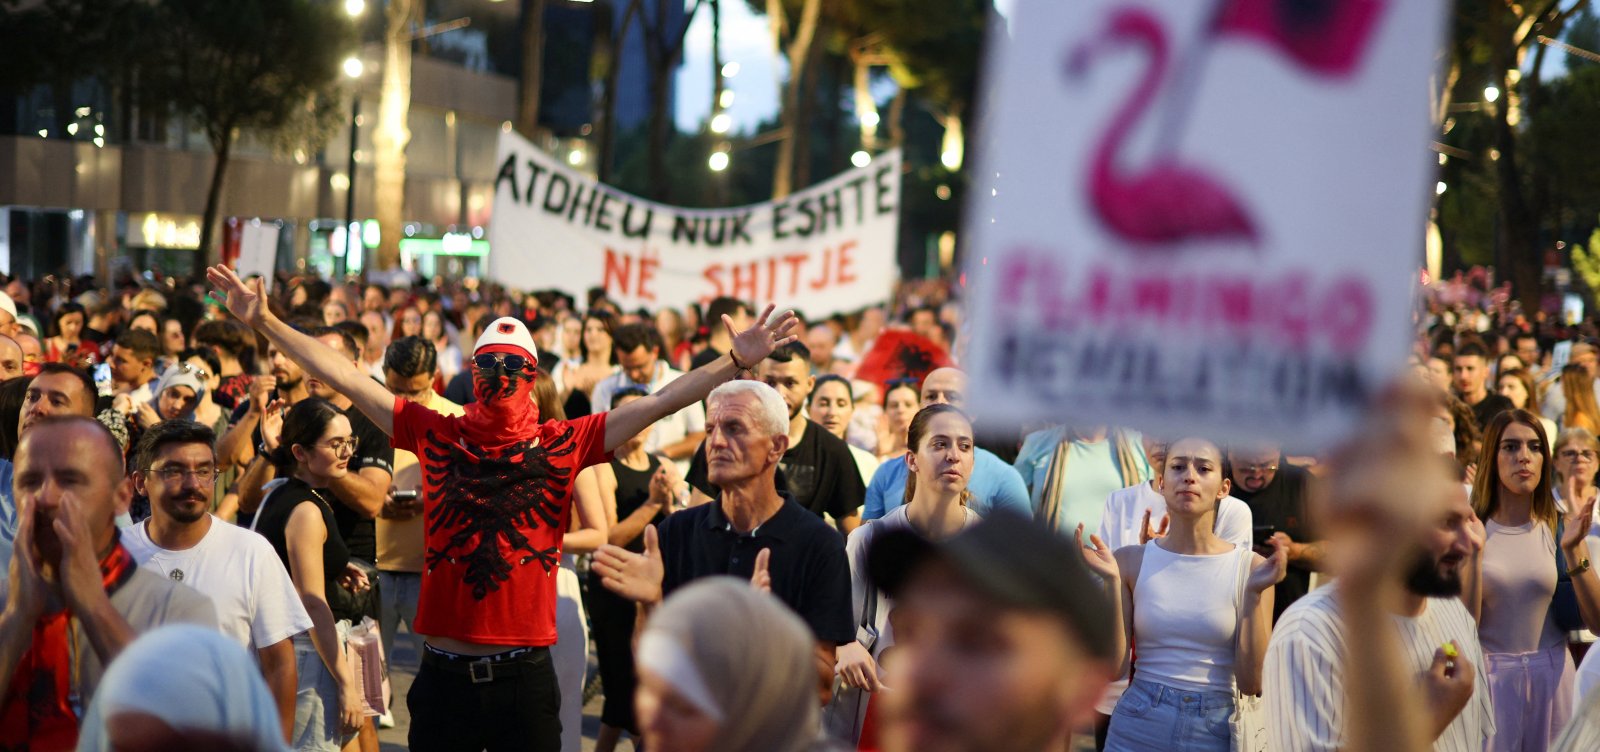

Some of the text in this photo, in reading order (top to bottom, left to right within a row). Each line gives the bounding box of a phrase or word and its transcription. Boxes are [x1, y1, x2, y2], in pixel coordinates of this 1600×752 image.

[494, 151, 893, 247] ATDHEU NUK ESHTE
[699, 240, 859, 303] SHITJE
